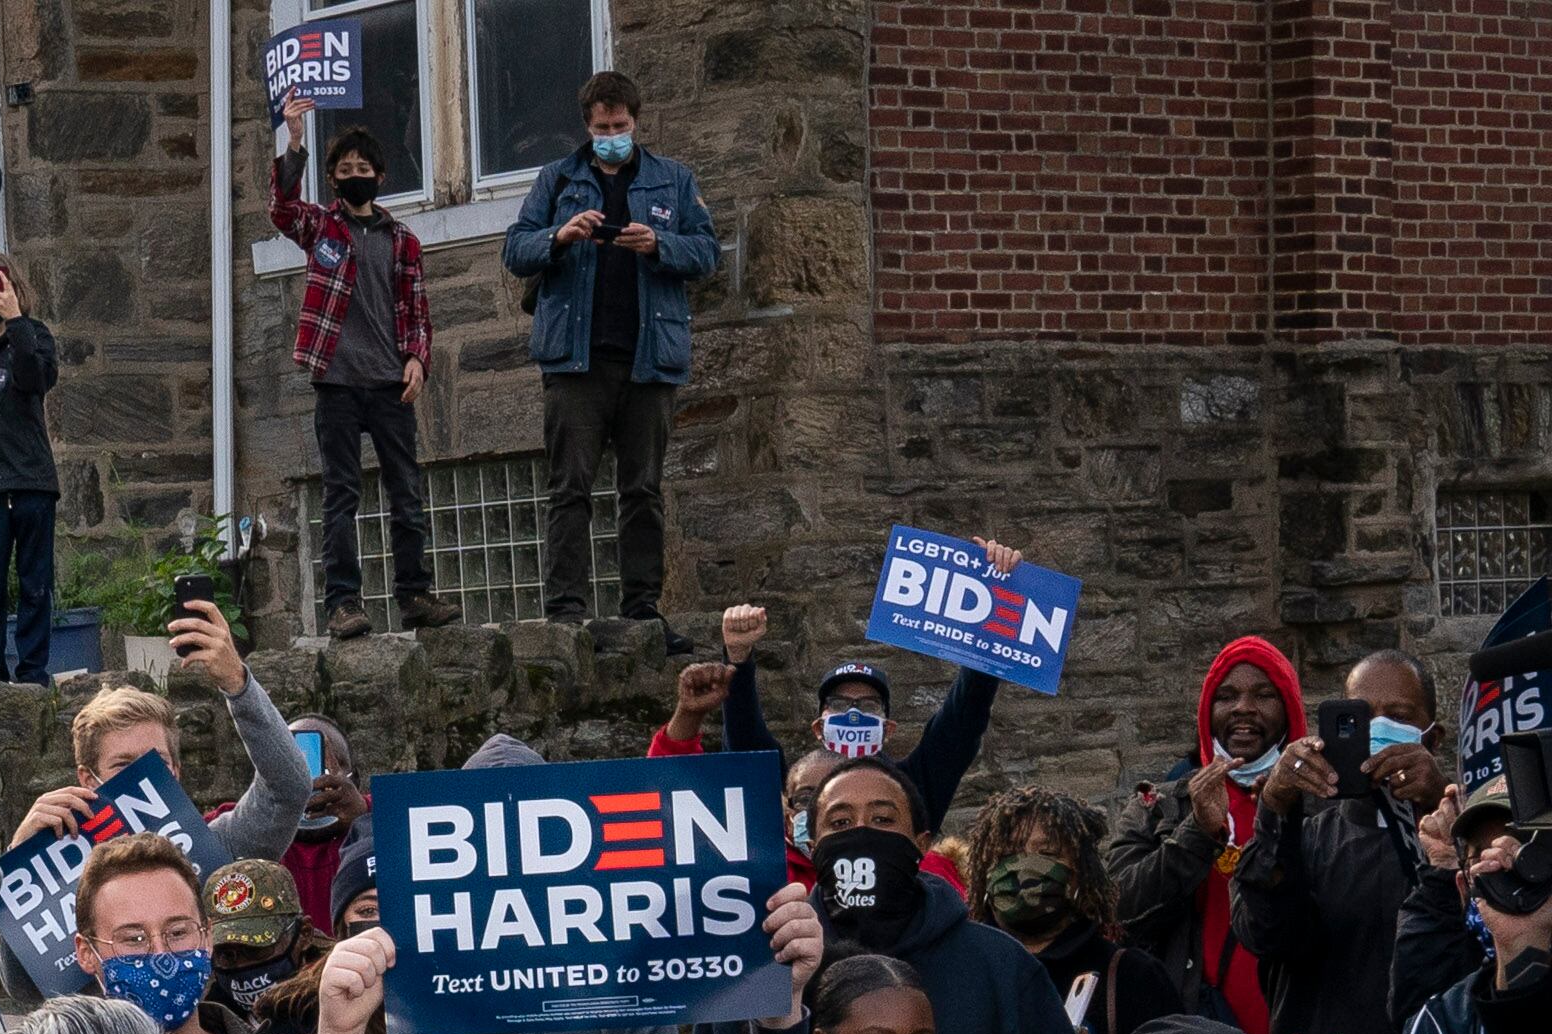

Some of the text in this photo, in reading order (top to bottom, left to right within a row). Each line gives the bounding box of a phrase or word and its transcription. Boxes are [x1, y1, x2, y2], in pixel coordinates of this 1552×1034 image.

[266, 32, 349, 77] BIDEN
[269, 60, 351, 100] HARRIS
[314, 87, 346, 96] 30330
[895, 536, 982, 569] LGBTQ+
[882, 556, 1068, 654] BIDEN
[892, 612, 920, 629] Text
[923, 620, 974, 644] PRIDE
[977, 638, 990, 650] to
[991, 643, 1042, 668] 30330
[837, 728, 871, 743] VOTE
[1461, 687, 1544, 760] RRIS
[1477, 766, 1489, 780] to
[408, 786, 748, 882] BIDEN
[834, 857, 876, 890] 98
[414, 874, 756, 953] HARRIS
[54, 954, 79, 973] Tex
[231, 973, 272, 992] BLACK
[433, 954, 743, 994] Text UNITED to 30330
